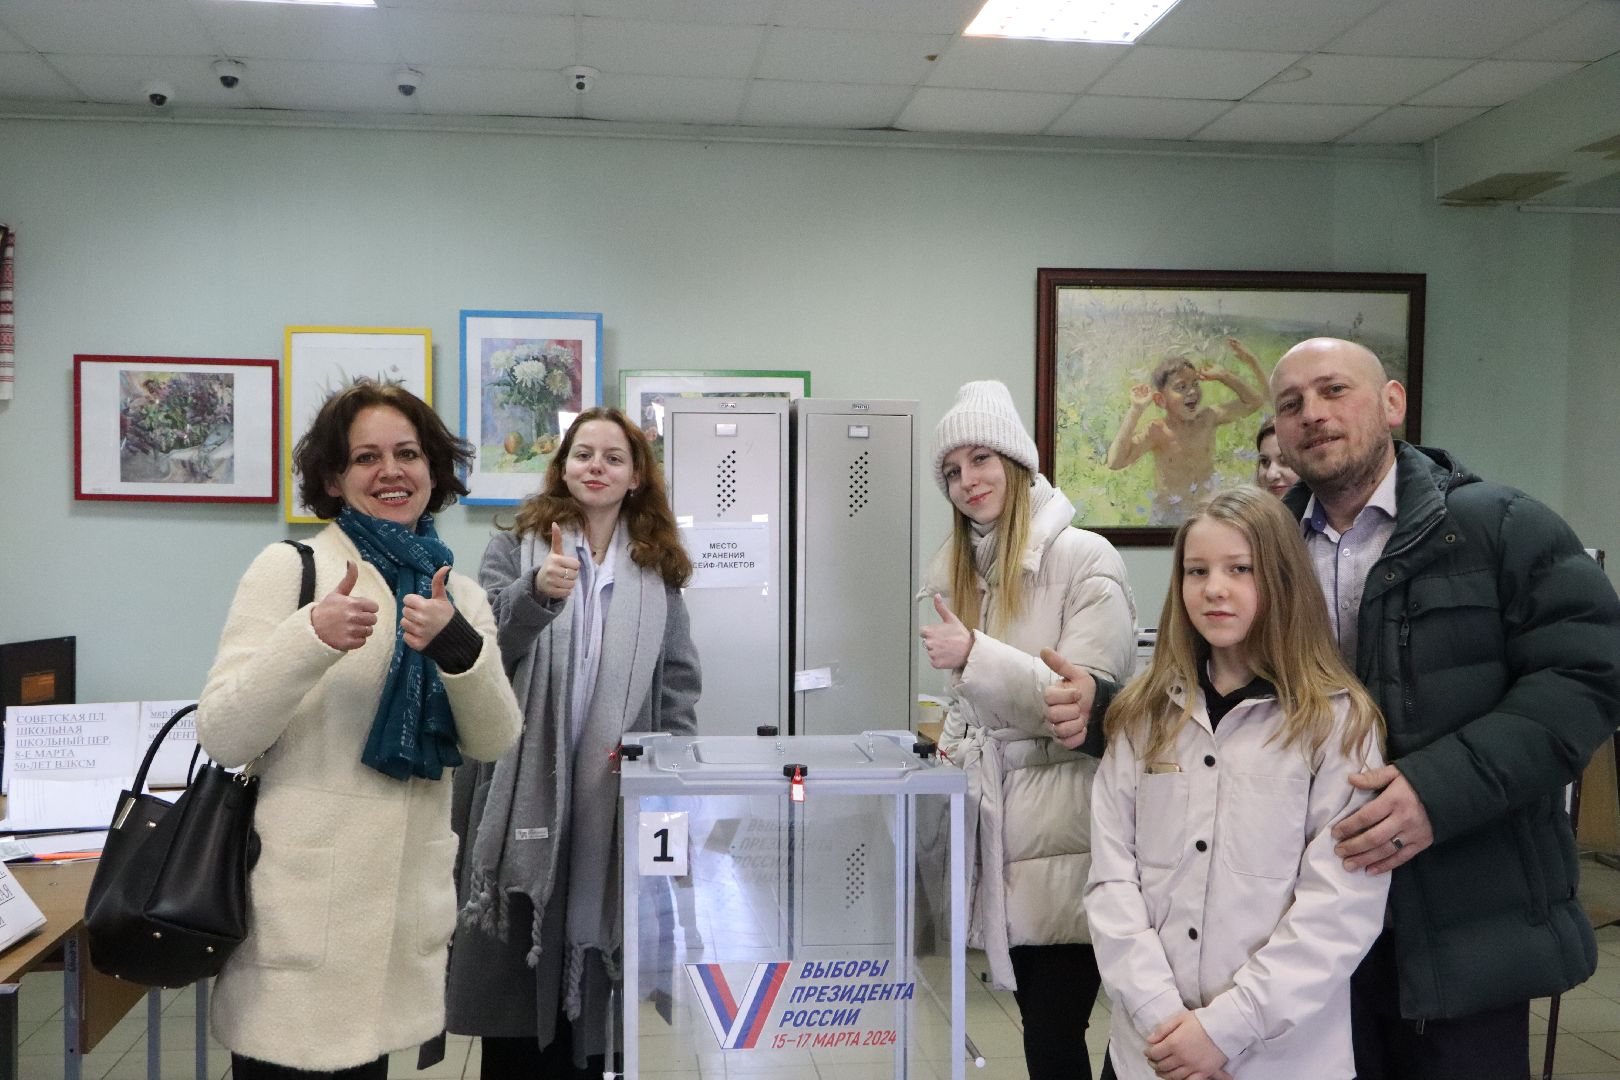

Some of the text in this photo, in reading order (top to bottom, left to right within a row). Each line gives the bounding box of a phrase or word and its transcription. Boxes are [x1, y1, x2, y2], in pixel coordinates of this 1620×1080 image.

[709, 542, 738, 550] МЕСТО
[702, 551, 745, 559] ХРАНЕНИЯ
[692, 560, 755, 569] СЕЙФ-ПАКЕТОВ
[16, 713, 86, 724] СОВЕТСКАЯ
[16, 725, 83, 736] ШКОЛЬНАЯ
[16, 736, 85, 748] ШКОЛЬНЫЙ
[35, 749, 76, 759] МАРТА
[55, 759, 96, 769] ВЛКСМ
[653, 828, 675, 863] 1
[800, 959, 890, 979] ВЫБОРЫ
[789, 982, 915, 1004] ПРЕЗИДЕНТА
[779, 1008, 862, 1028] РОССИИ
[812, 1031, 861, 1048] МАРТА
[862, 1030, 897, 1046] 2024
